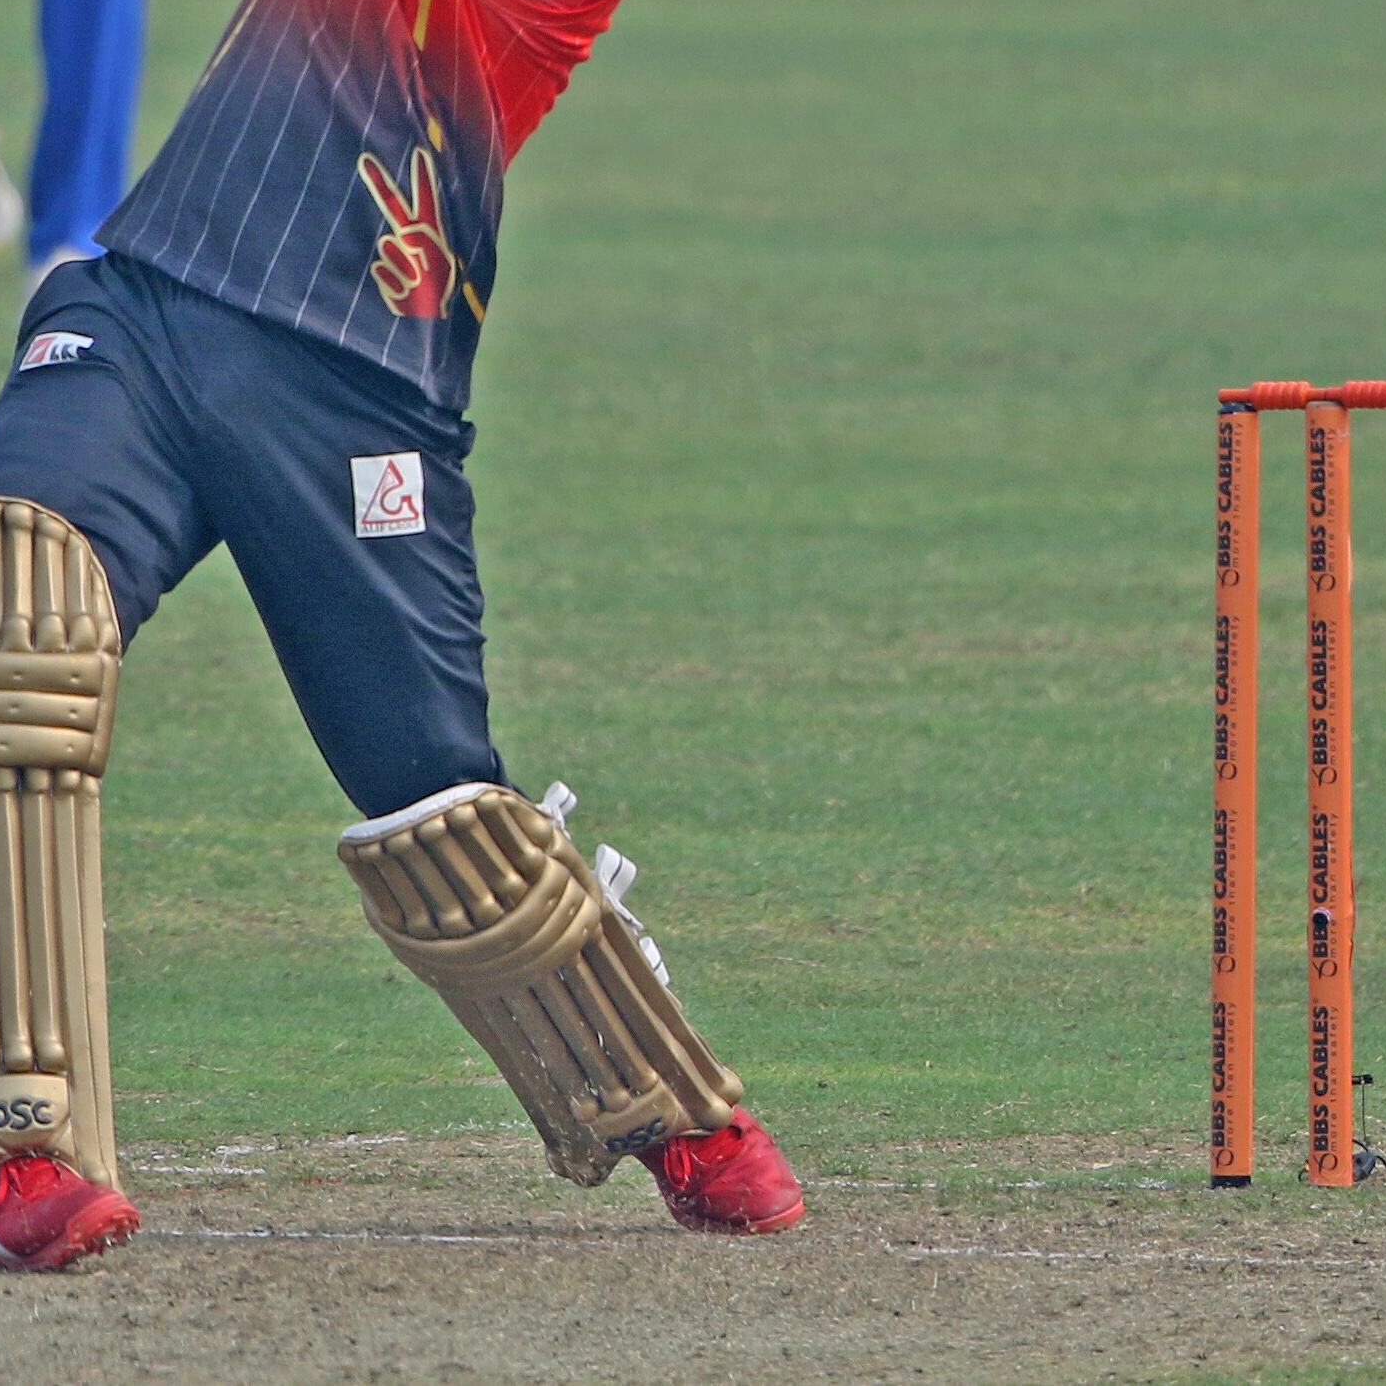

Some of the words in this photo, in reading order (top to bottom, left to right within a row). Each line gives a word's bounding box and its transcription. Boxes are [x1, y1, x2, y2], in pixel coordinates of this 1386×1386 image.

[1218, 421, 1233, 513] CABLES
[1310, 427, 1326, 517] CABLES
[1217, 519, 1231, 567] BBS
[1311, 524, 1326, 572] BBS
[1216, 615, 1230, 705] CABLES
[1312, 619, 1328, 711] CABLES
[1216, 713, 1229, 760] BBS
[1312, 718, 1328, 765] BBS
[1214, 809, 1228, 899] CABLES
[1312, 812, 1329, 904] CABLES
[1214, 906, 1227, 954] BBS
[1312, 912, 1329, 958] BB
[1213, 1002, 1226, 1092] CABLES
[1313, 1005, 1329, 1097] CABLES
[606, 1117, 668, 1153] DSC
[1212, 1100, 1225, 1147] BBS
[1314, 1103, 1329, 1151] BBS
